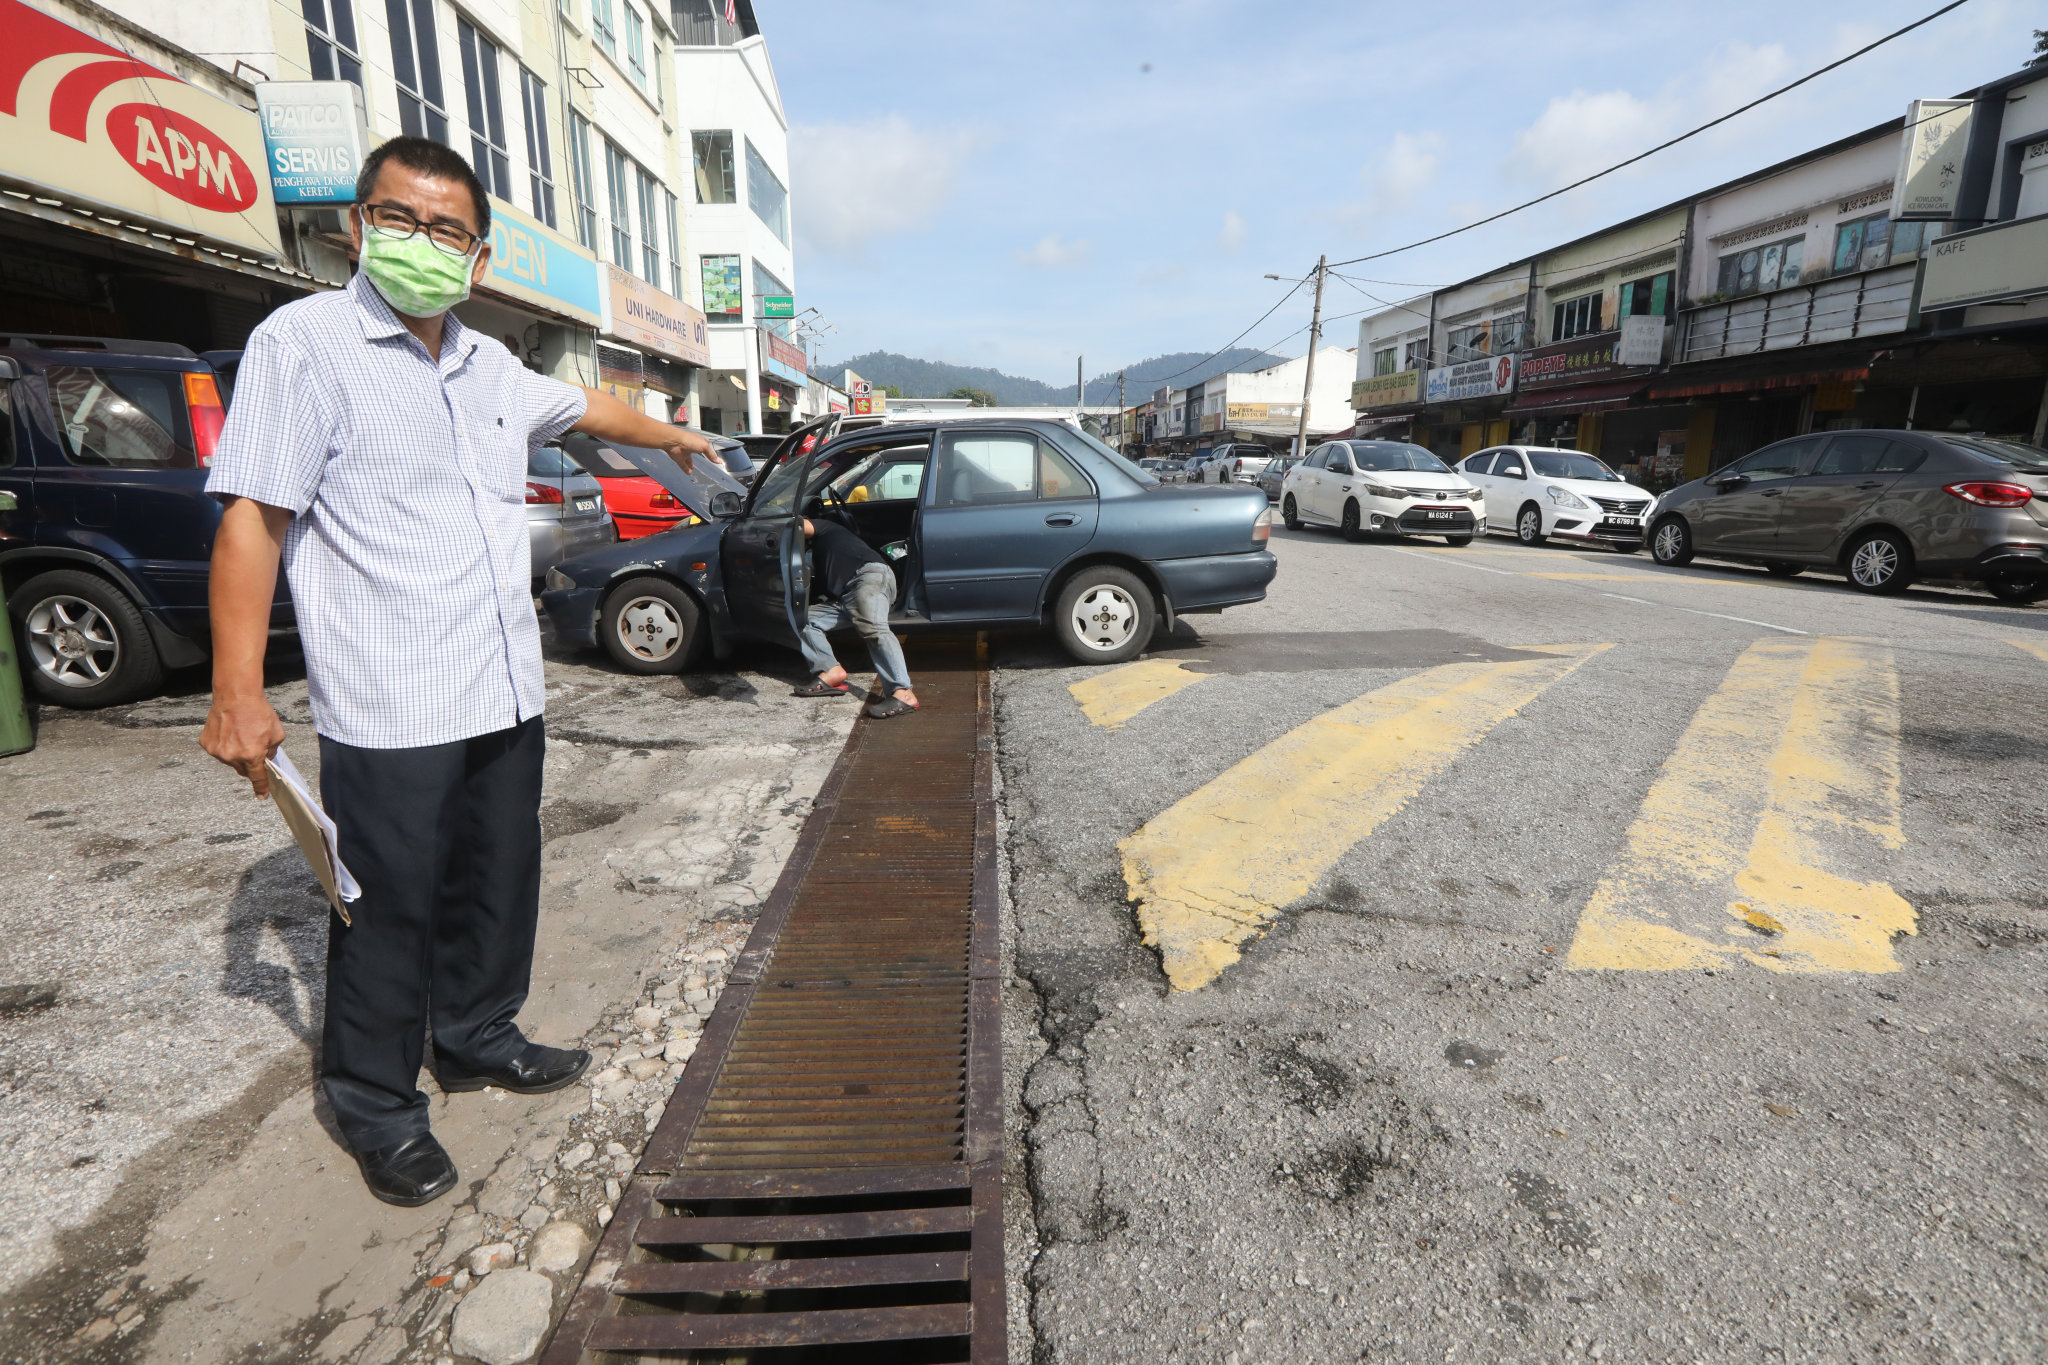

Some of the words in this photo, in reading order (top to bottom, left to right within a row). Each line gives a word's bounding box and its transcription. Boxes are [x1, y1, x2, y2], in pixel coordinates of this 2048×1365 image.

[269, 104, 342, 128] PATCO
[135, 115, 243, 202] APM
[274, 146, 351, 173] SERVIS
[273, 176, 321, 187] PENGHAWA
[323, 175, 358, 186] DINGIN
[299, 186, 335, 197] KERETA
[1936, 240, 1967, 257] KAFE
[765, 302, 792, 311] Schneider
[625, 297, 644, 320] UNI
[645, 305, 687, 338] HARDWARE
[1520, 353, 1567, 378] POPEYE
[855, 382, 870, 394] 4D
